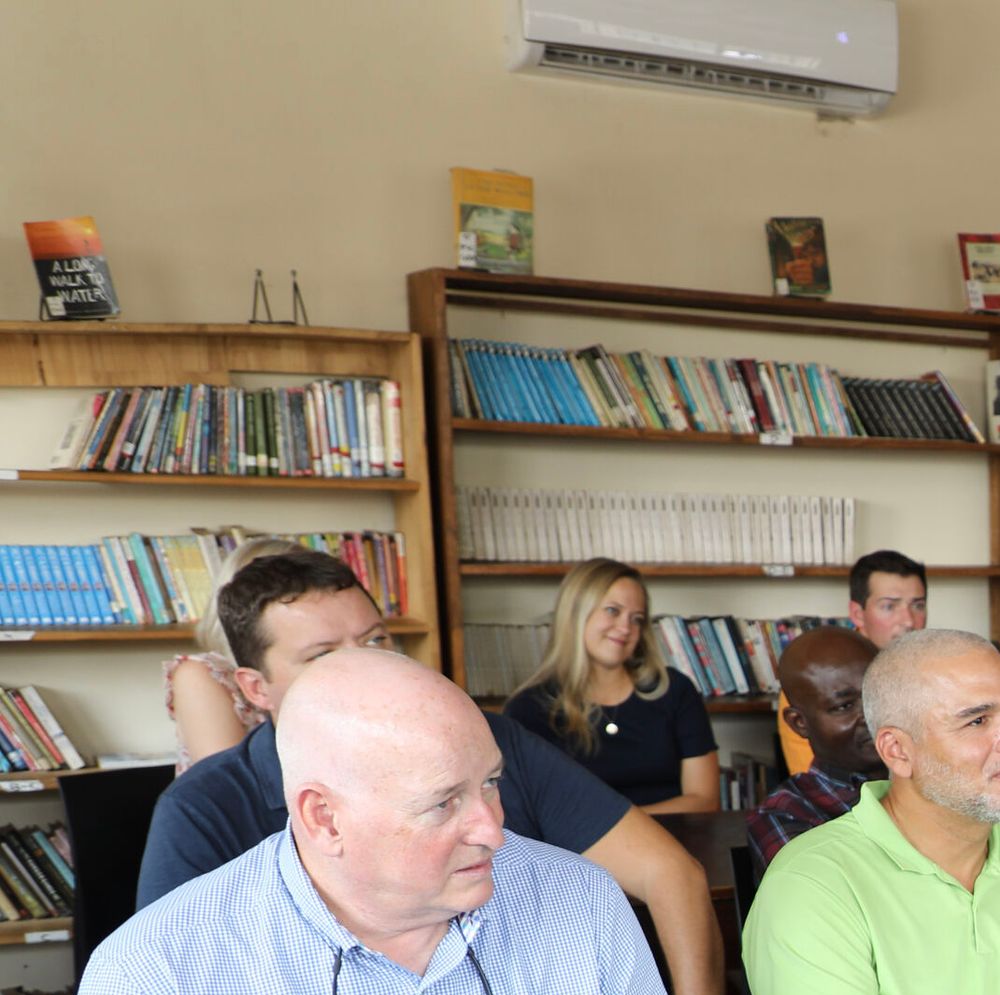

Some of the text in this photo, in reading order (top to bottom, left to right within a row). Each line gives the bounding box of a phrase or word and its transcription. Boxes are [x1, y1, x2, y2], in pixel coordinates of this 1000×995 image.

[52, 257, 96, 273] A LONG
[49, 272, 104, 287] WALK TO
[57, 288, 106, 303] WATER
